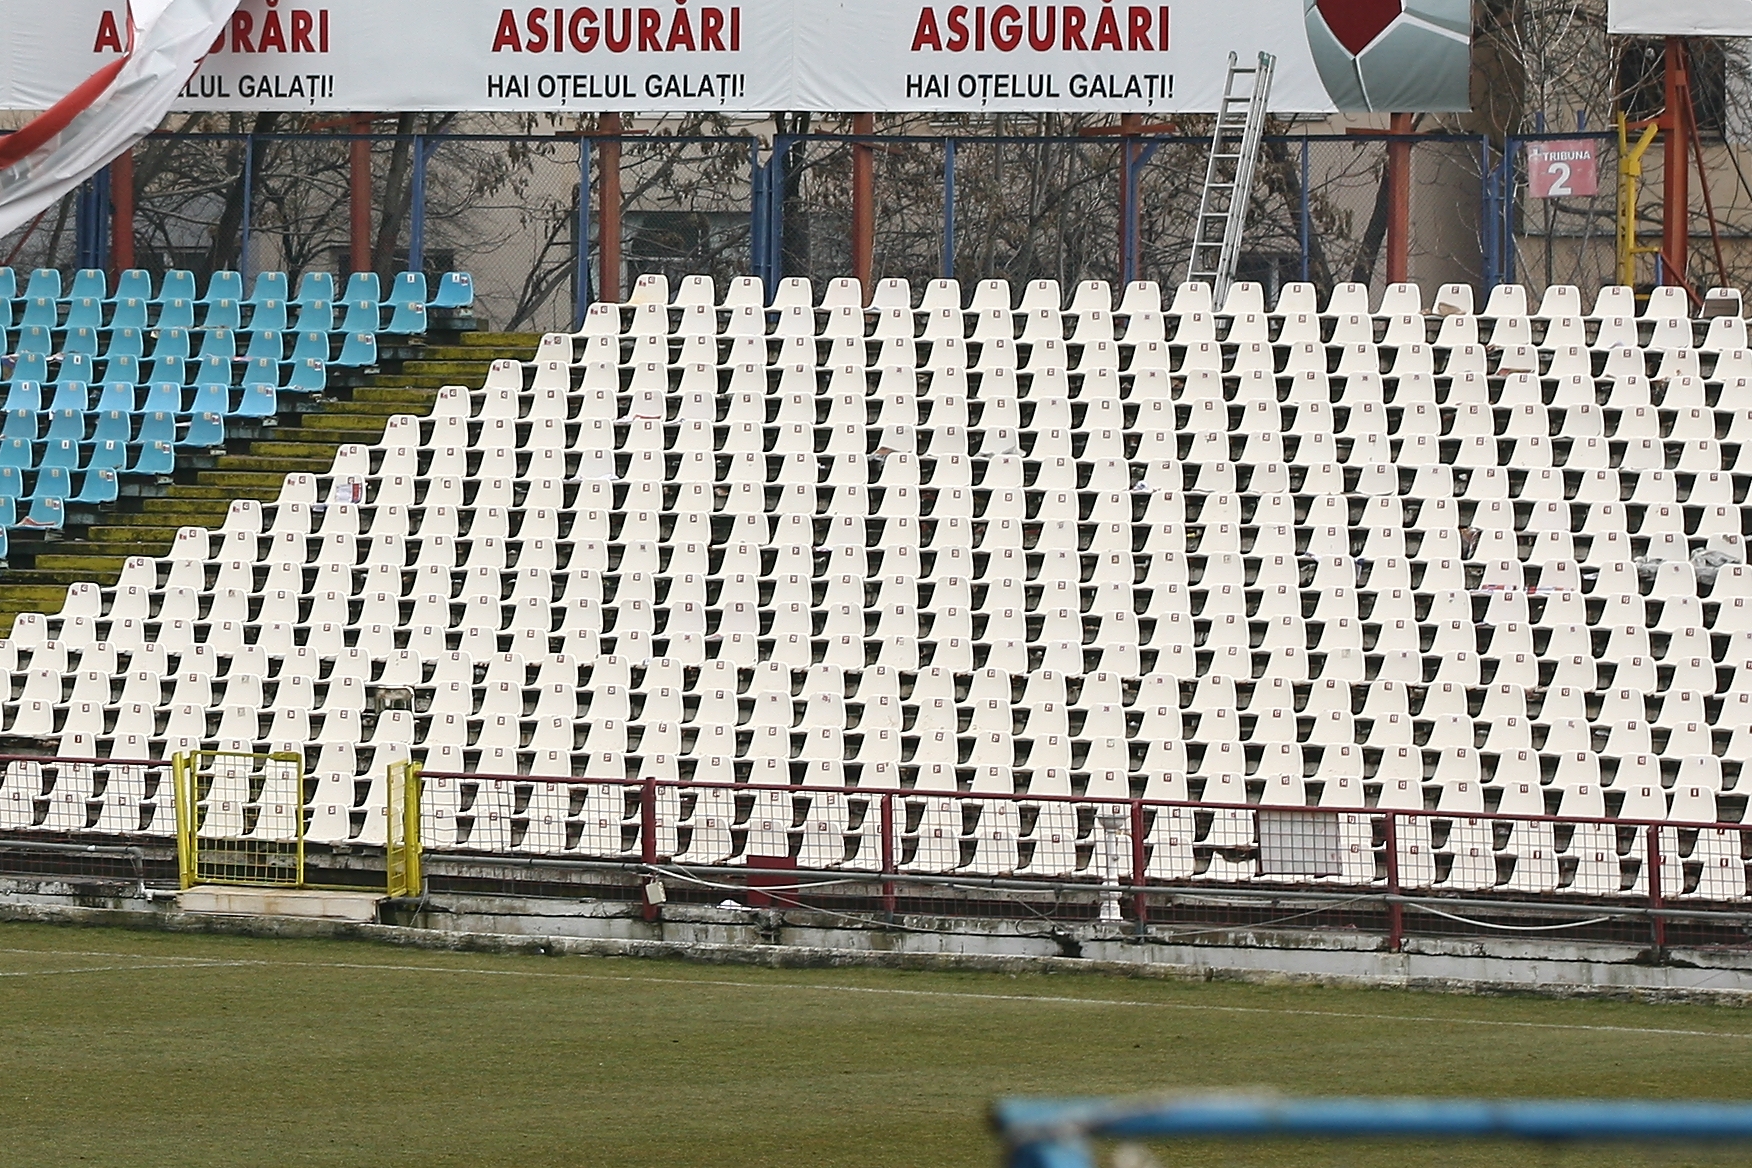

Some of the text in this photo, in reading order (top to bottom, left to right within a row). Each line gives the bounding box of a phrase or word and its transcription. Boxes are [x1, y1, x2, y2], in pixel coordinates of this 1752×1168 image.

[487, 74, 529, 98] HAI
[645, 73, 745, 106] GALAȚI!
[906, 74, 949, 98] HAI
[1069, 73, 1174, 107] GALAȚI!
[1543, 150, 1591, 161] TRIBUNA
[1547, 161, 1572, 196] 2
